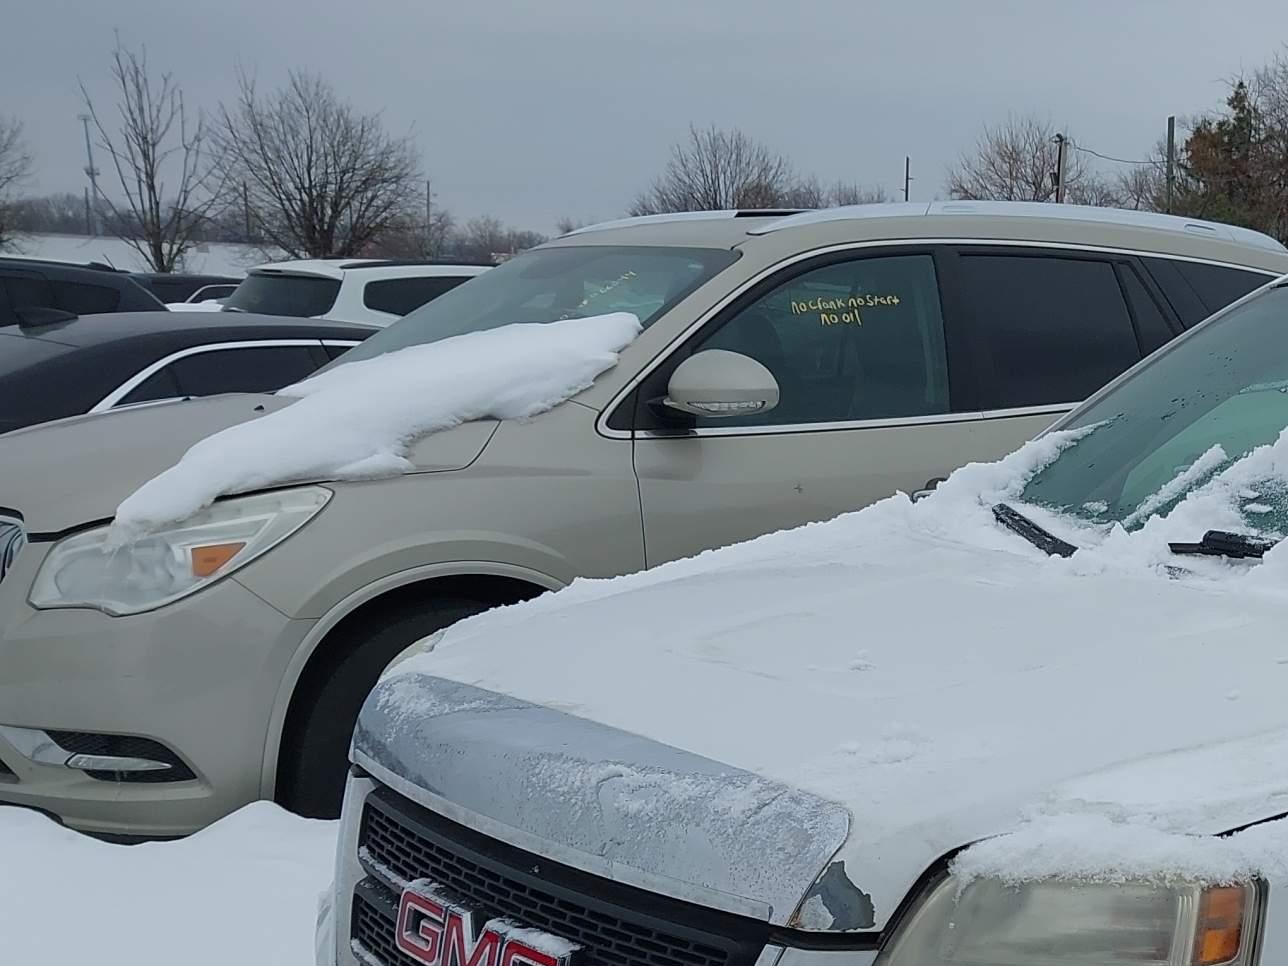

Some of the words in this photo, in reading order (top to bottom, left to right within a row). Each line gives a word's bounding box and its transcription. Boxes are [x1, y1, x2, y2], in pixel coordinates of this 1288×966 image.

[791, 301, 807, 315] no
[848, 298, 865, 308] no
[820, 313, 839, 326] no
